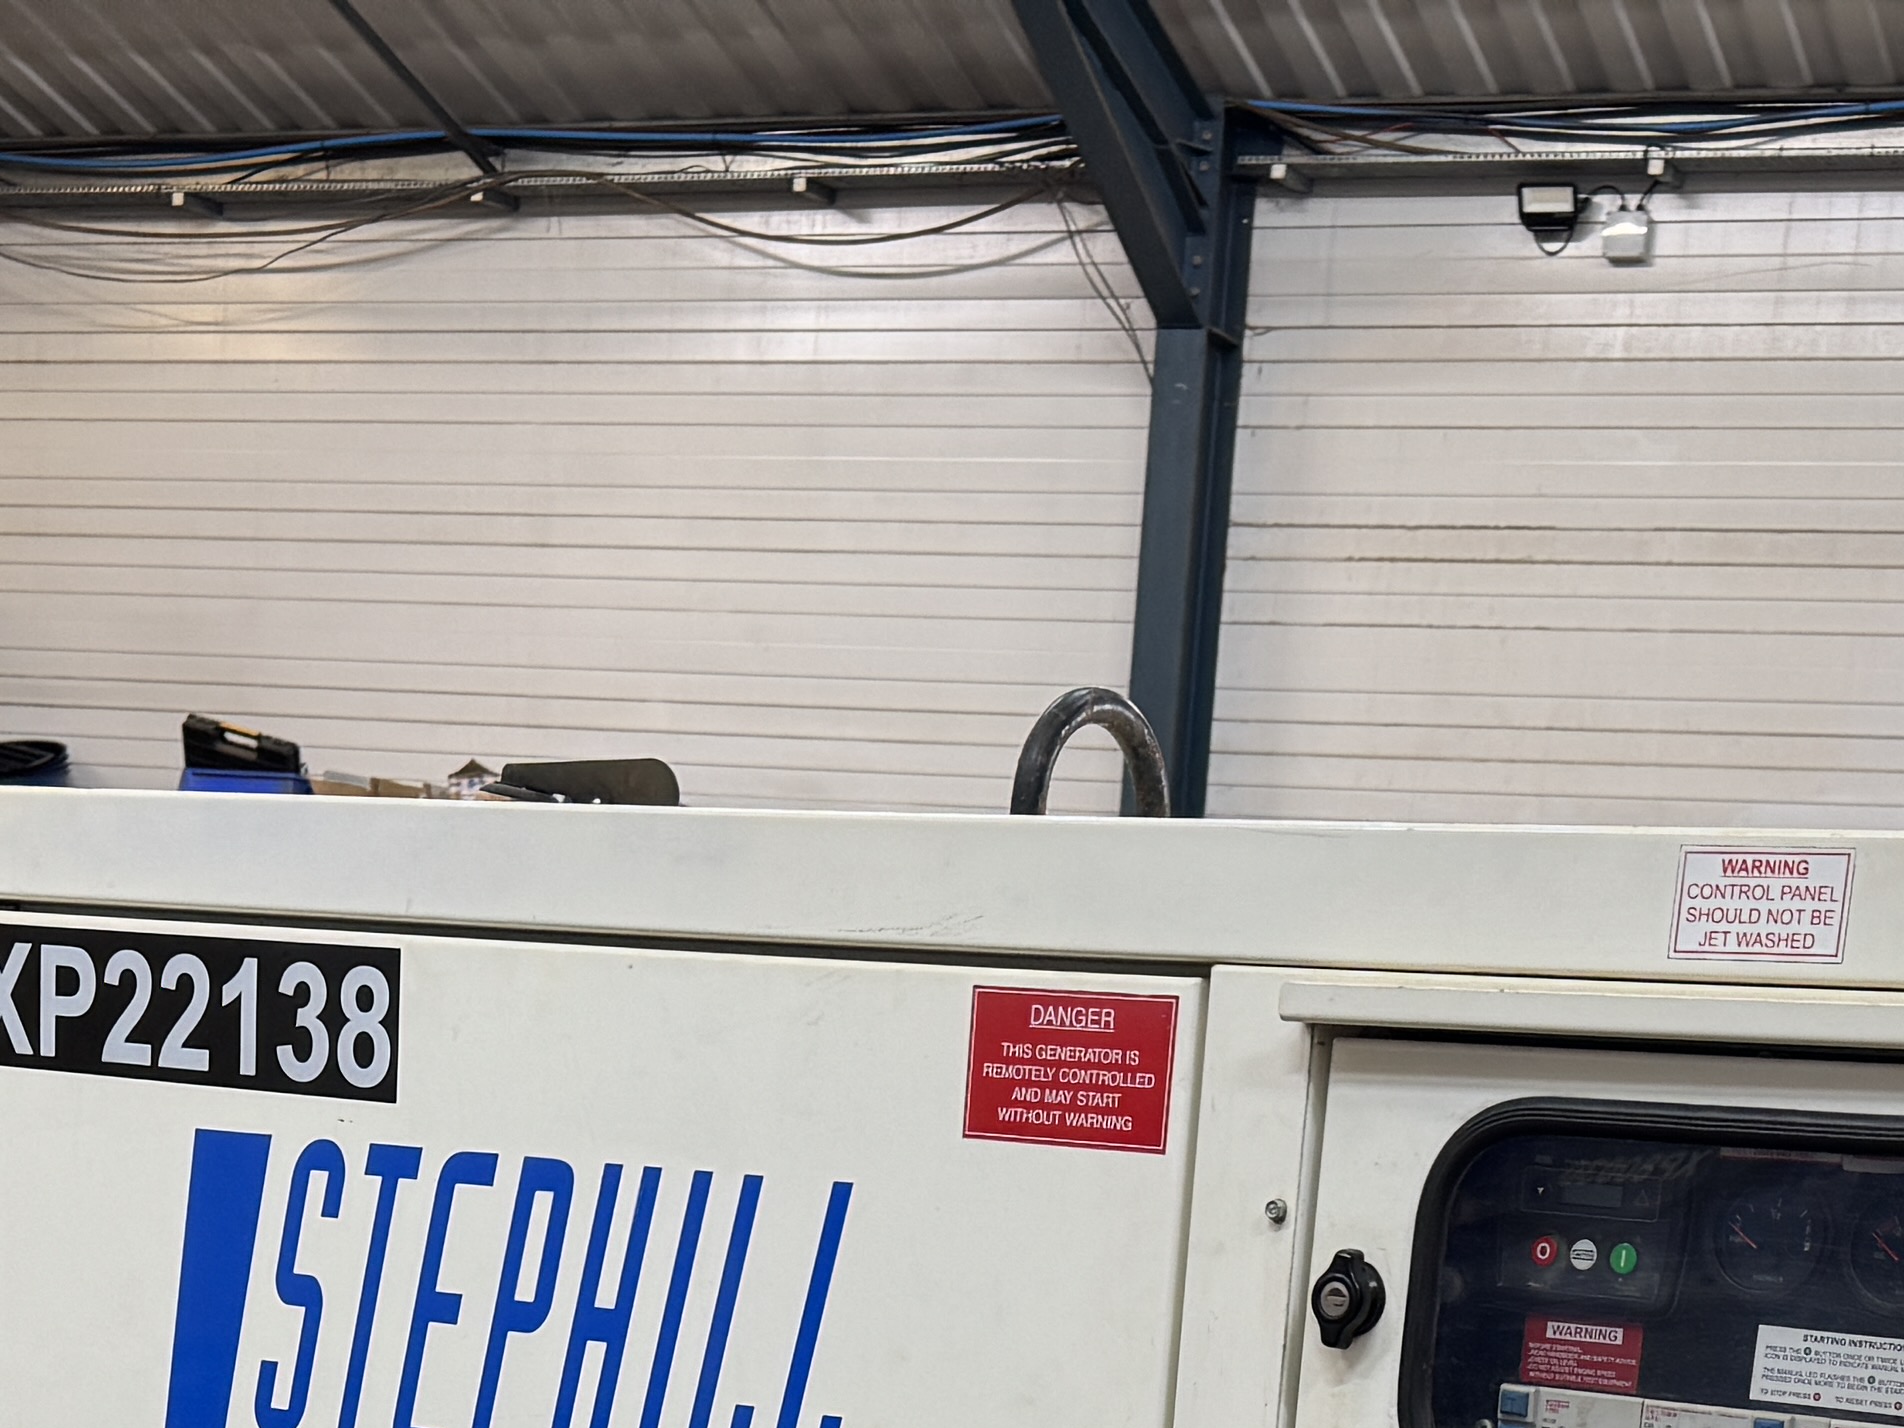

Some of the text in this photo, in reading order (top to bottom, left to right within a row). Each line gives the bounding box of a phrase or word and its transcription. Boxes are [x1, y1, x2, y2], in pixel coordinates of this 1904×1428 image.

[1721, 858, 1809, 876] WARNING
[1687, 883, 1839, 902] CONTROL PANEL
[1686, 907, 1836, 926] SHOULD NOT BE
[1699, 931, 1815, 949] JET WASHED
[1030, 1005, 1115, 1029] DANGER
[1001, 1042, 1139, 1065] THIS GENERATOR IS
[983, 1063, 1155, 1088] REMOTELY CONTROLLED
[1011, 1087, 1122, 1108] AND MAY START
[997, 1107, 1132, 1131] WITHOUT WARNING
[1552, 1324, 1618, 1342] WARNING
[1802, 1334, 1846, 1346] STARTING
